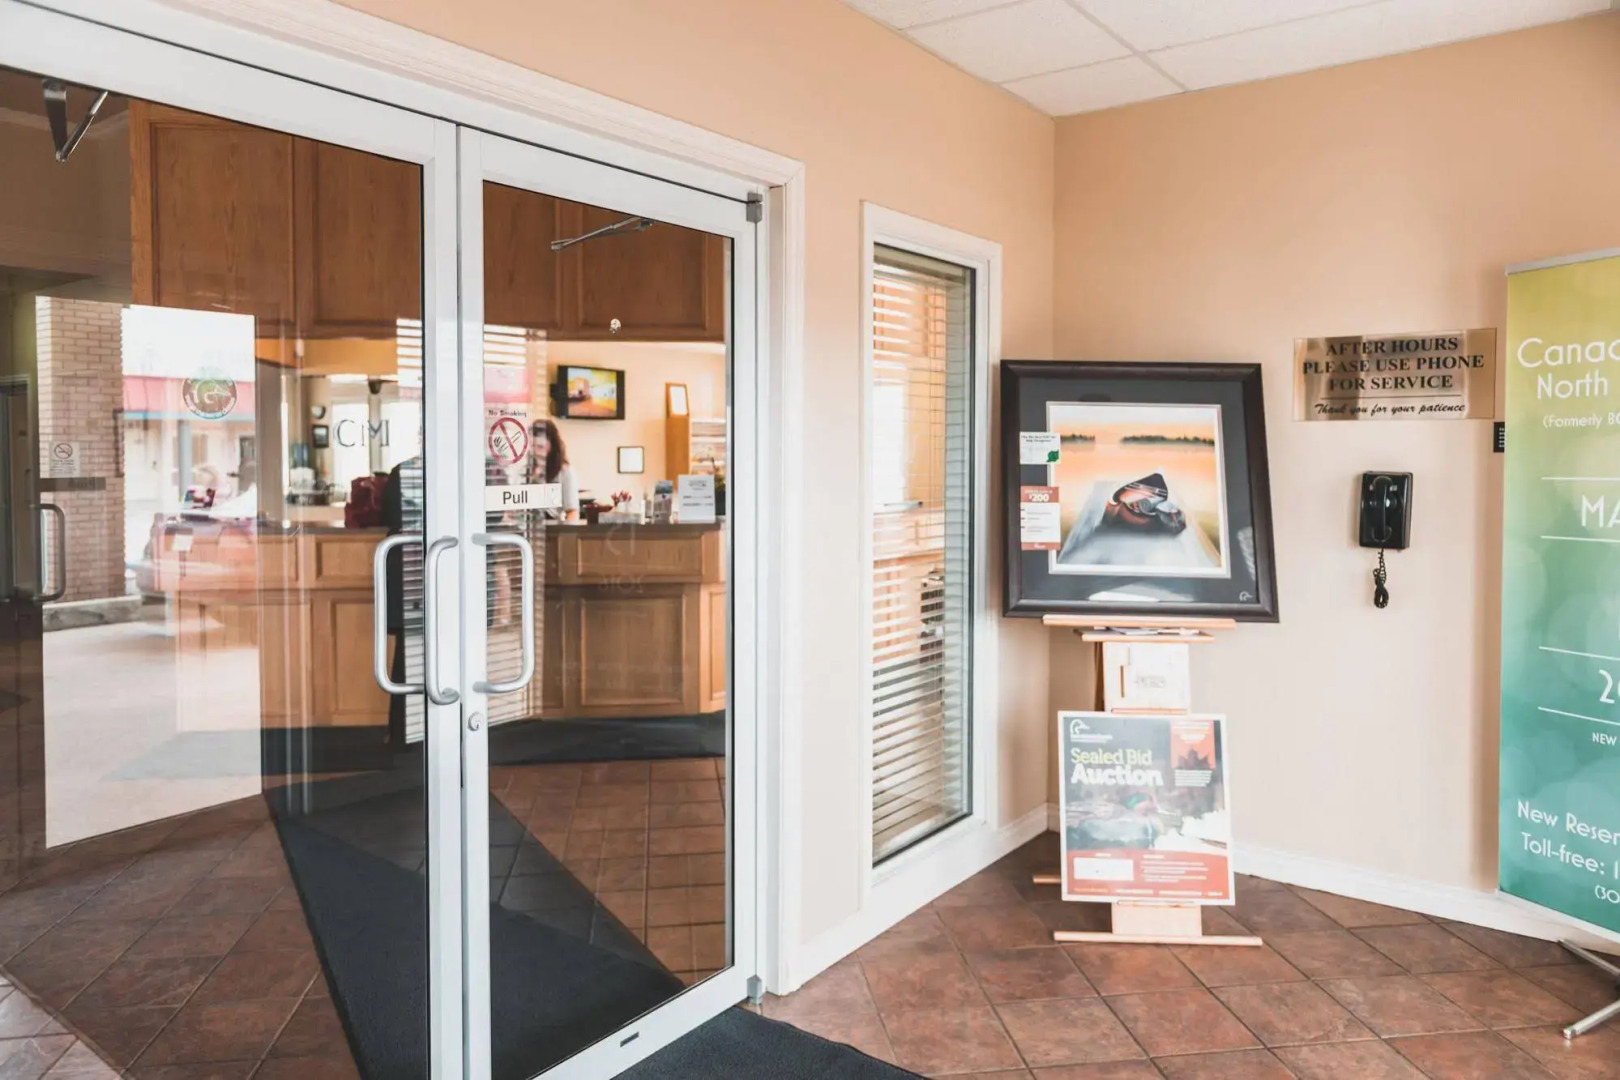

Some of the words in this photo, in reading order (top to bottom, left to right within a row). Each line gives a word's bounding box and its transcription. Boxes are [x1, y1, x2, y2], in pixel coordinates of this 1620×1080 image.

[1326, 340, 1386, 356] AFTER
[1392, 337, 1459, 354] HOURS
[1303, 359, 1370, 375] PLEASE
[1376, 358, 1411, 372] USE
[1416, 355, 1484, 371] PHONE
[1329, 378, 1365, 392] FOR
[1370, 375, 1453, 391] SERVICE
[1537, 369, 1608, 399] North
[500, 410, 527, 418] Smoking
[1314, 402, 1347, 414] Thank
[1349, 405, 1368, 416] you
[1370, 404, 1388, 417] for
[1391, 405, 1416, 416] your
[1418, 403, 1466, 414] patience
[1543, 413, 1602, 429] (Formerly
[502, 490, 528, 505] Pull
[1028, 493, 1050, 502] $200
[1599, 669, 1620, 704] 2
[1592, 731, 1617, 746] NEW
[1070, 747, 1124, 765] Sealed
[1126, 749, 1152, 765] Bid
[1070, 763, 1163, 786] Auction
[1517, 799, 1558, 827] New
[1521, 831, 1605, 875] Toll-free:
